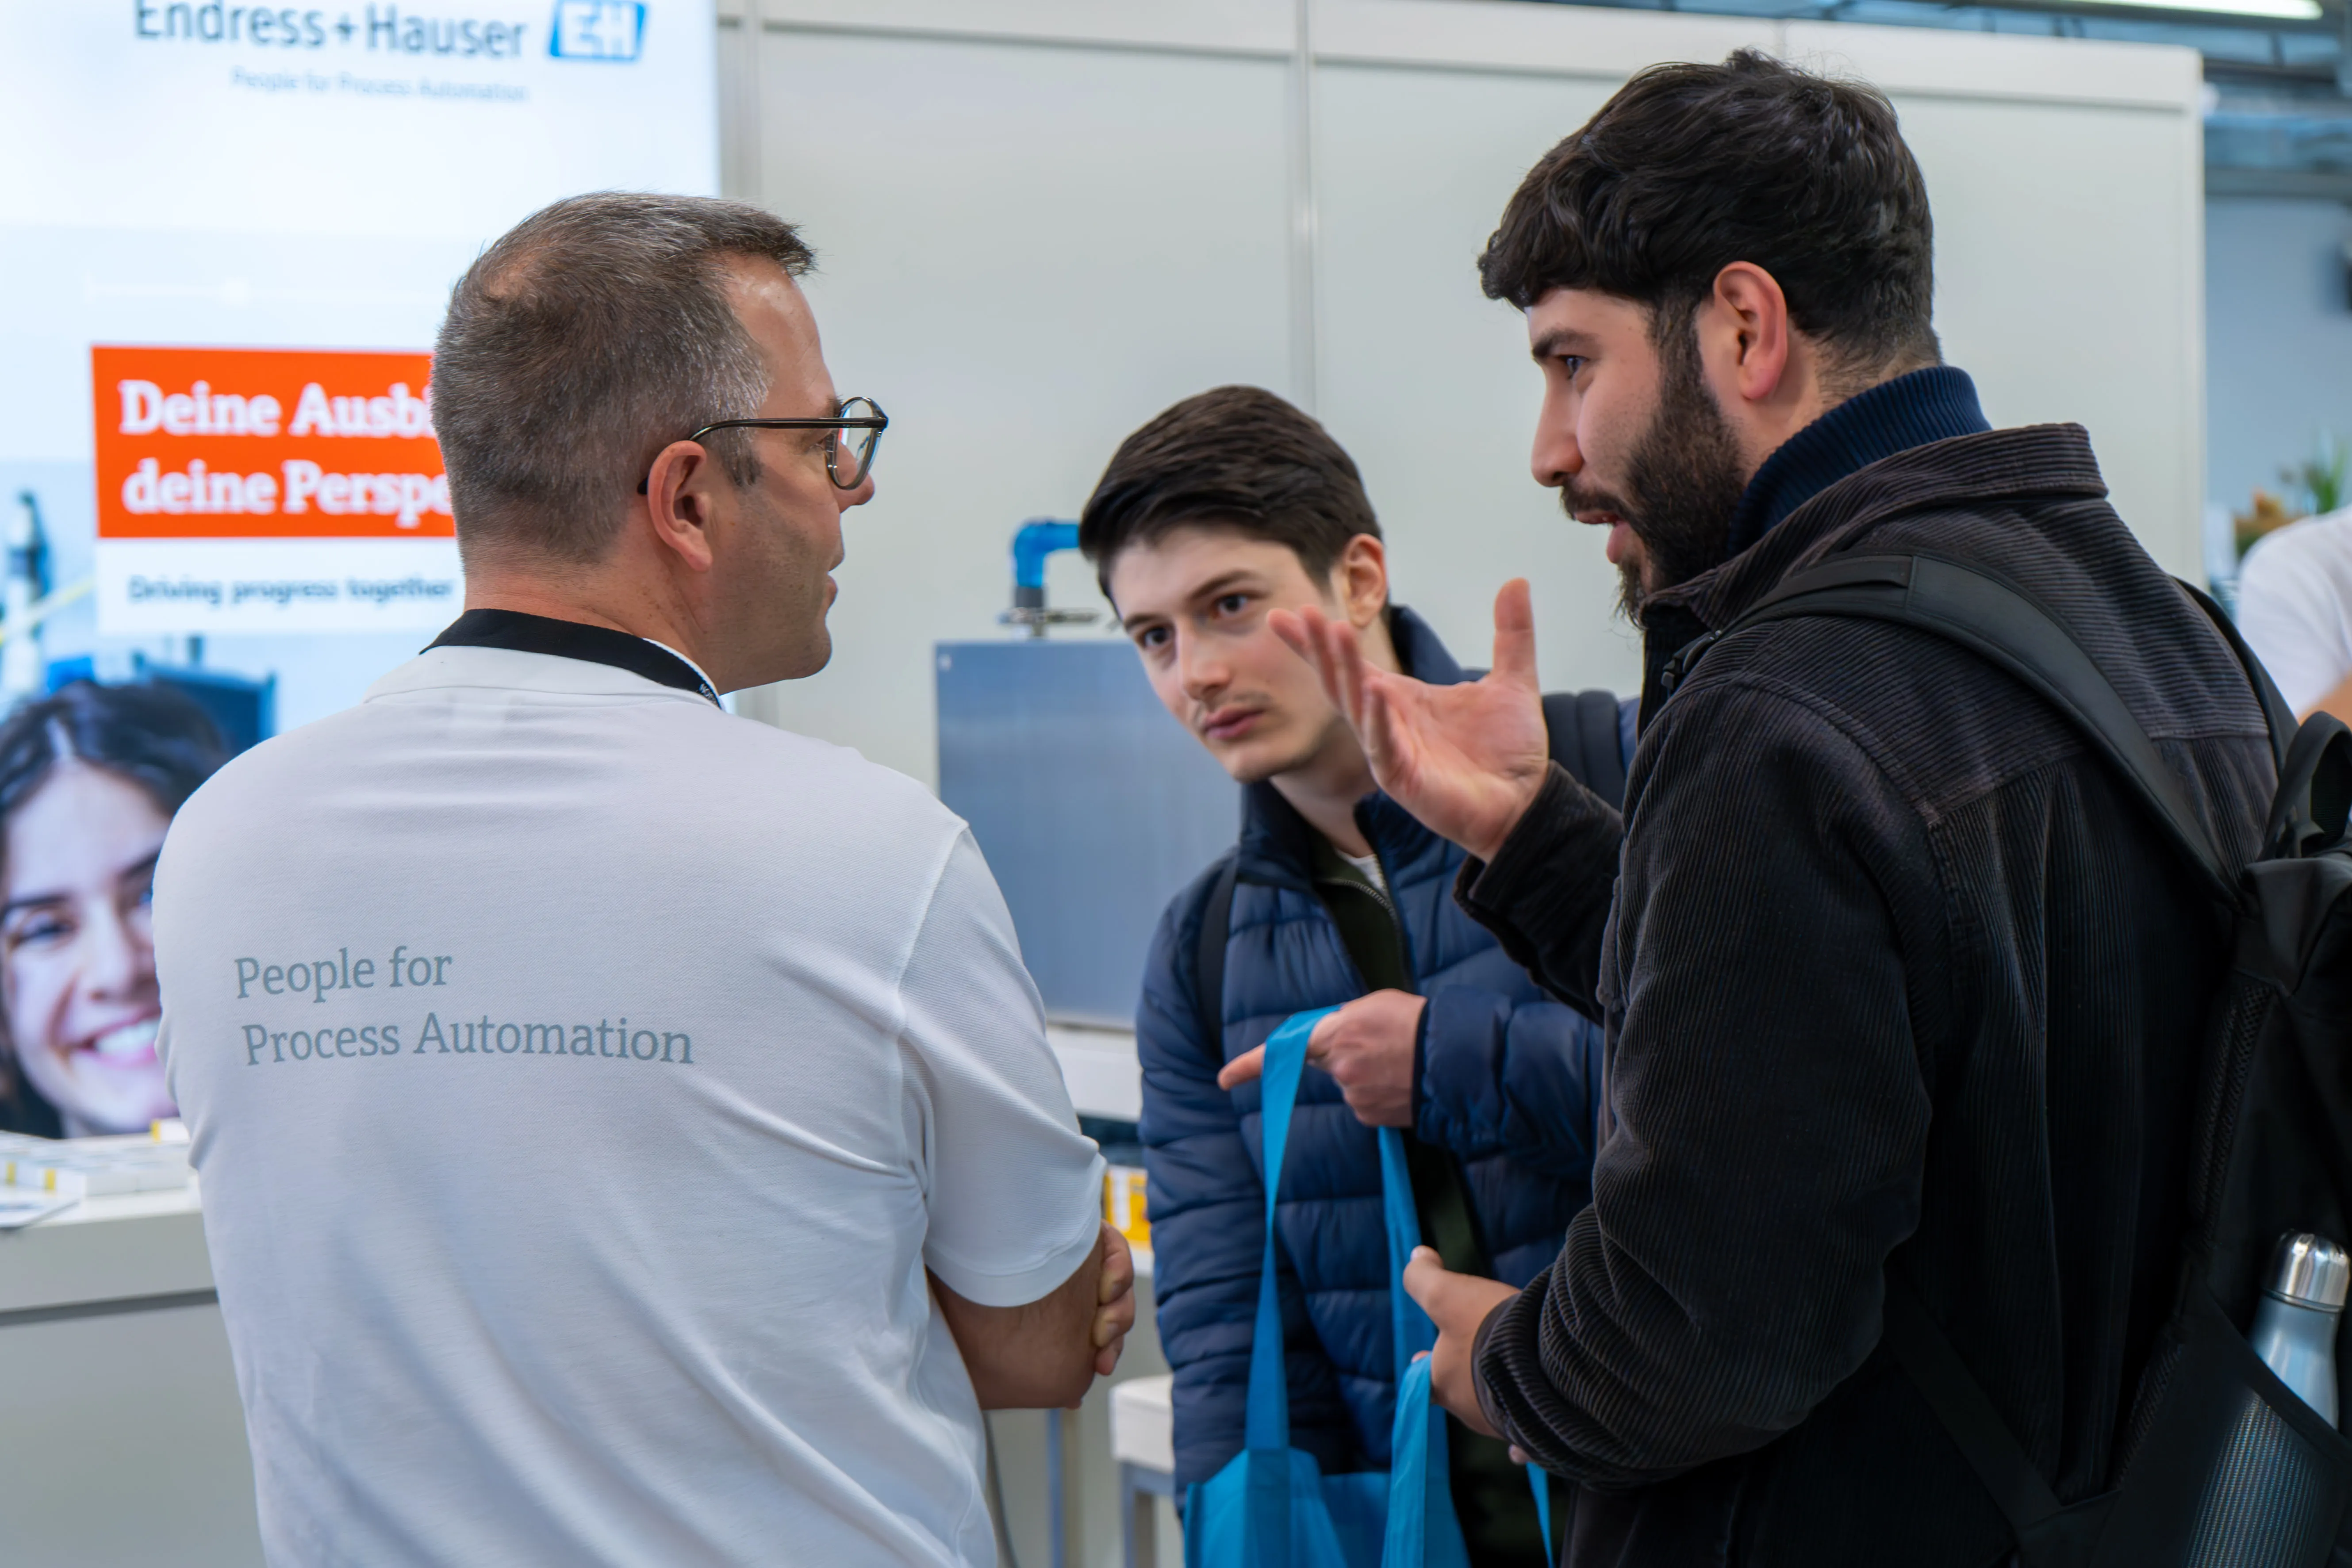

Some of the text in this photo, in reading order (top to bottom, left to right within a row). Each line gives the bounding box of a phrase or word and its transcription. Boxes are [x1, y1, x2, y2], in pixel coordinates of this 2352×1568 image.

[232, 65, 526, 102] People for Process Automation
[119, 380, 282, 436] Deine
[121, 458, 278, 515] deine
[128, 575, 453, 606] Driving progress together
[234, 946, 452, 1003] People for
[242, 1012, 694, 1066] Process Automation
